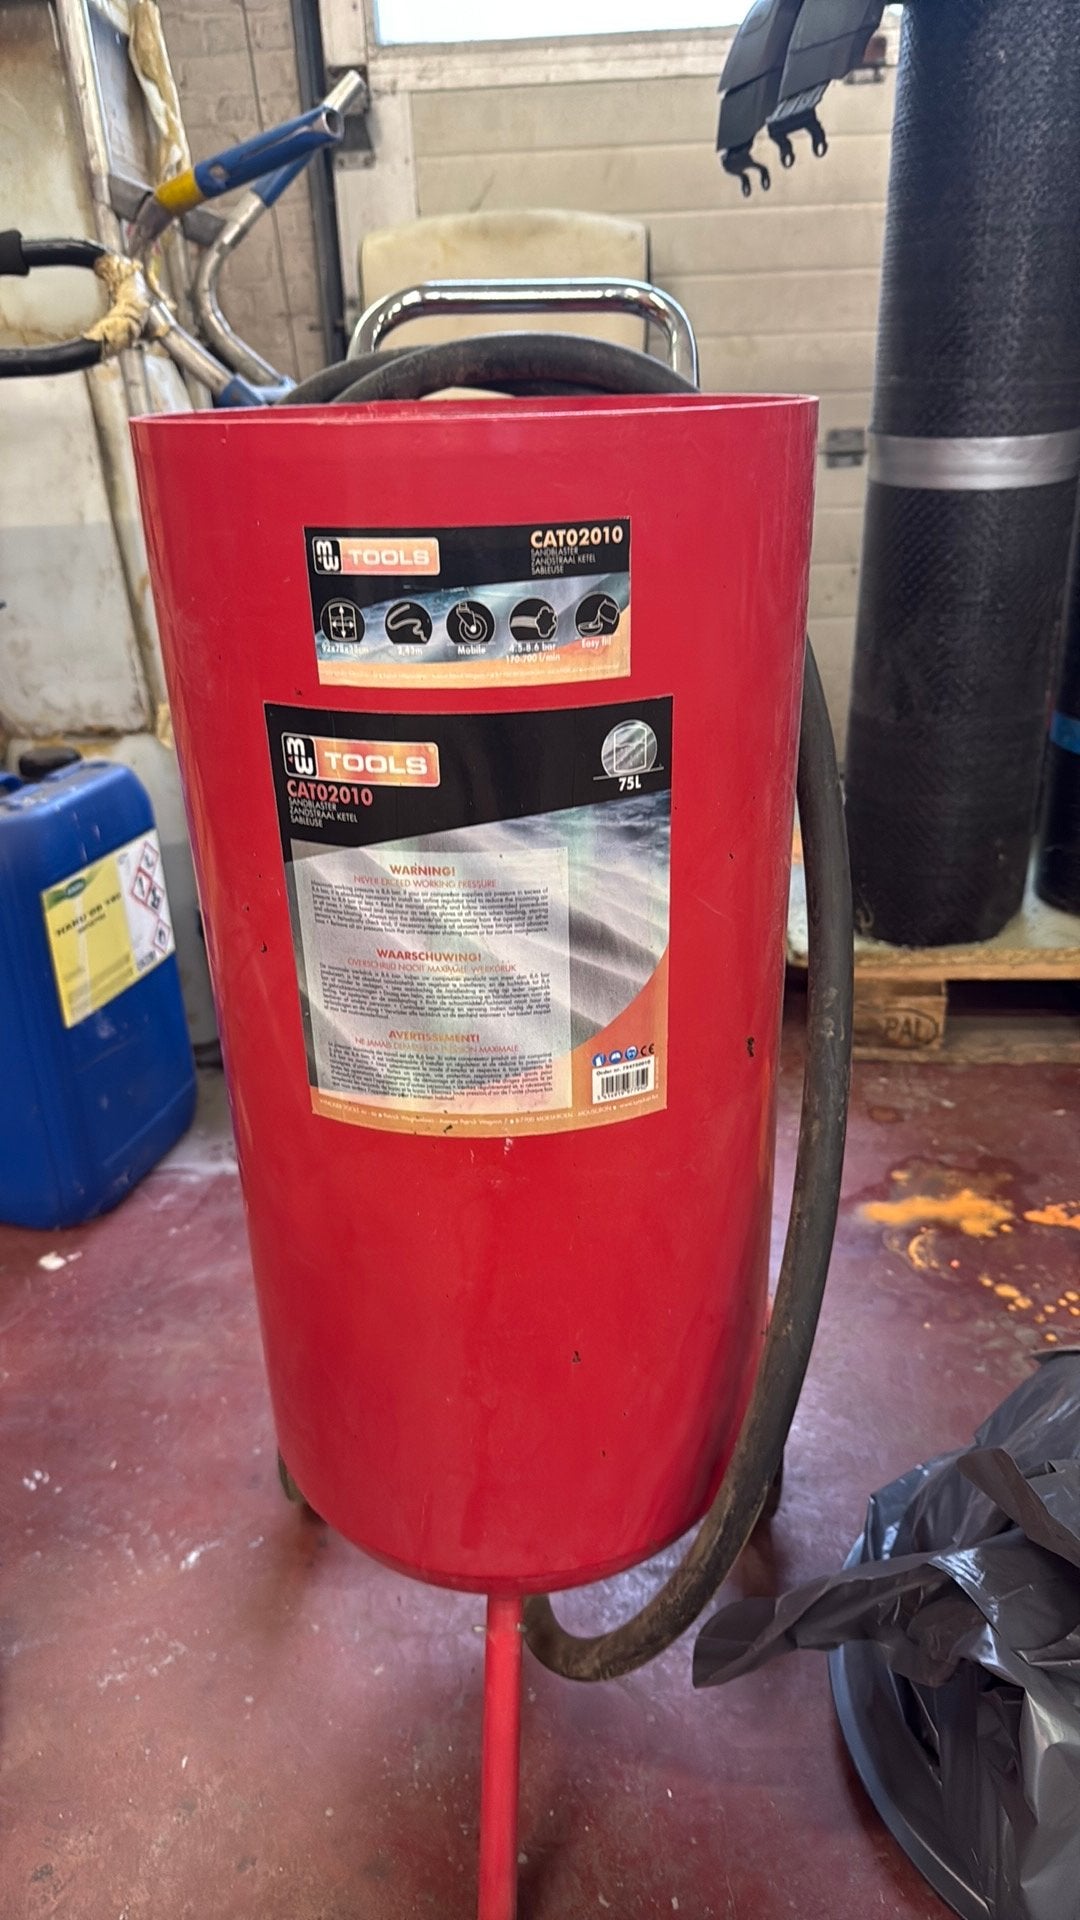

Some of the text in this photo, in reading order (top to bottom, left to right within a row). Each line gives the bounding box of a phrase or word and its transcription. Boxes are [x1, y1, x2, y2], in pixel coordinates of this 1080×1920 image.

[530, 525, 623, 549] CAT02010
[348, 549, 430, 566] TOOLS
[531, 546, 579, 557] SANDBLASTER
[532, 553, 596, 566] ZANDSTRAAL KETEL
[532, 565, 564, 576] SABLEUSE
[457, 643, 486, 656] Mobile
[542, 641, 556, 651] bar
[581, 637, 600, 650] Easy
[324, 751, 428, 776] TOOLS
[618, 775, 642, 792] 75L
[286, 779, 373, 807] CAT02010
[288, 797, 337, 812] SANDBLASTER
[289, 806, 358, 824] ZANDSTRAAL KETEL
[291, 814, 324, 828] SABLEUSE
[389, 864, 455, 876] WARNING!
[414, 879, 456, 889] WORKING
[458, 879, 497, 889] PRESSURE
[376, 948, 481, 962] WAARSCHUWING!
[347, 957, 397, 971] OVERSCHRIJD
[480, 1044, 520, 1054] MAXIMALE
